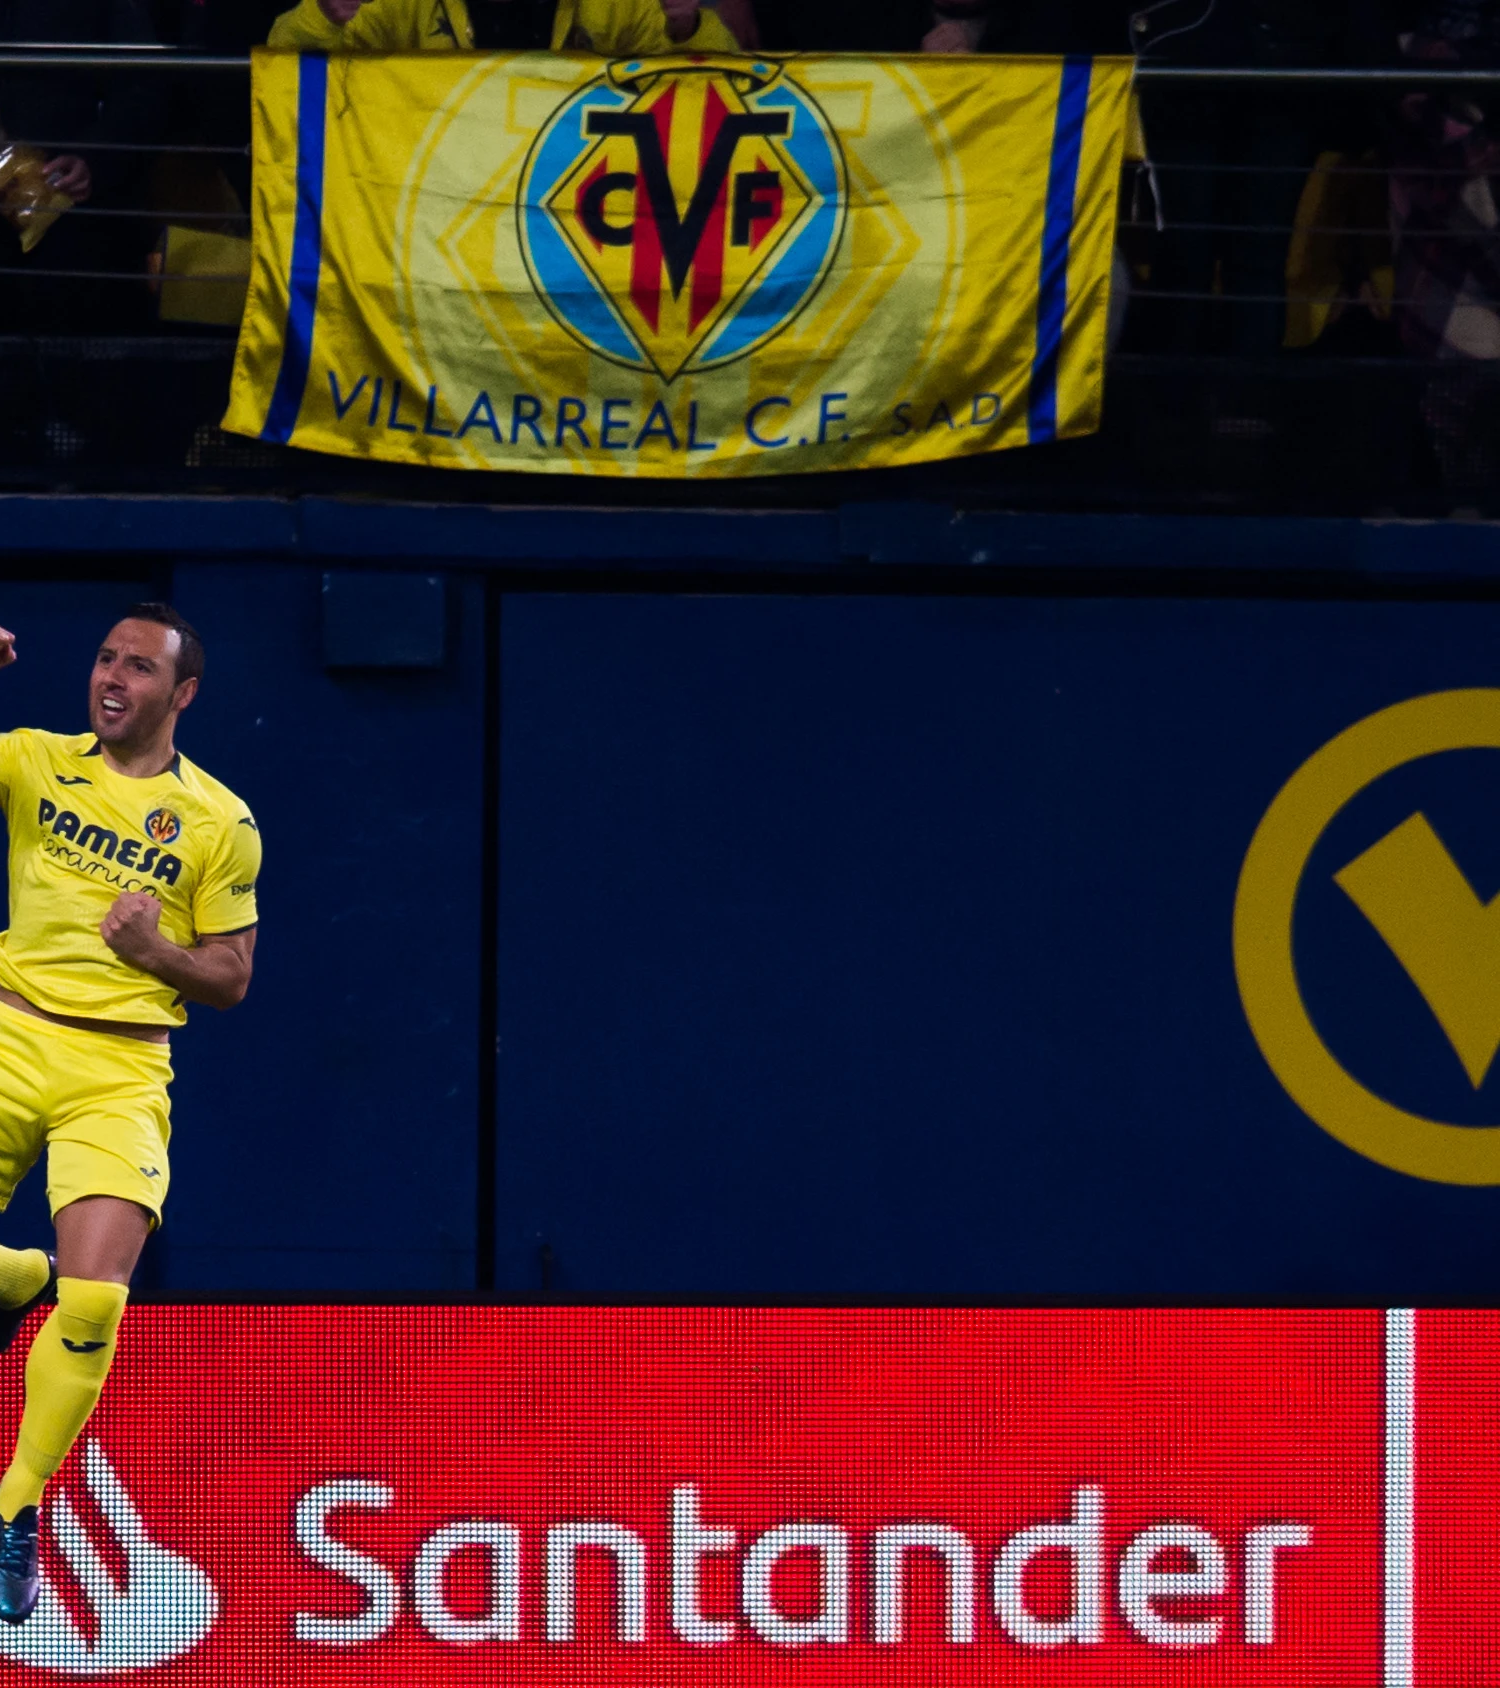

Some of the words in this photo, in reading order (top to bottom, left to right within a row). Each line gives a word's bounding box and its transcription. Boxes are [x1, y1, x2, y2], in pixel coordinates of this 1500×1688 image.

[328, 370, 718, 450] VILLARREAL
[744, 393, 850, 447] C.F.
[38, 797, 182, 886] PAMESA
[295, 1480, 1314, 1647] Santander
